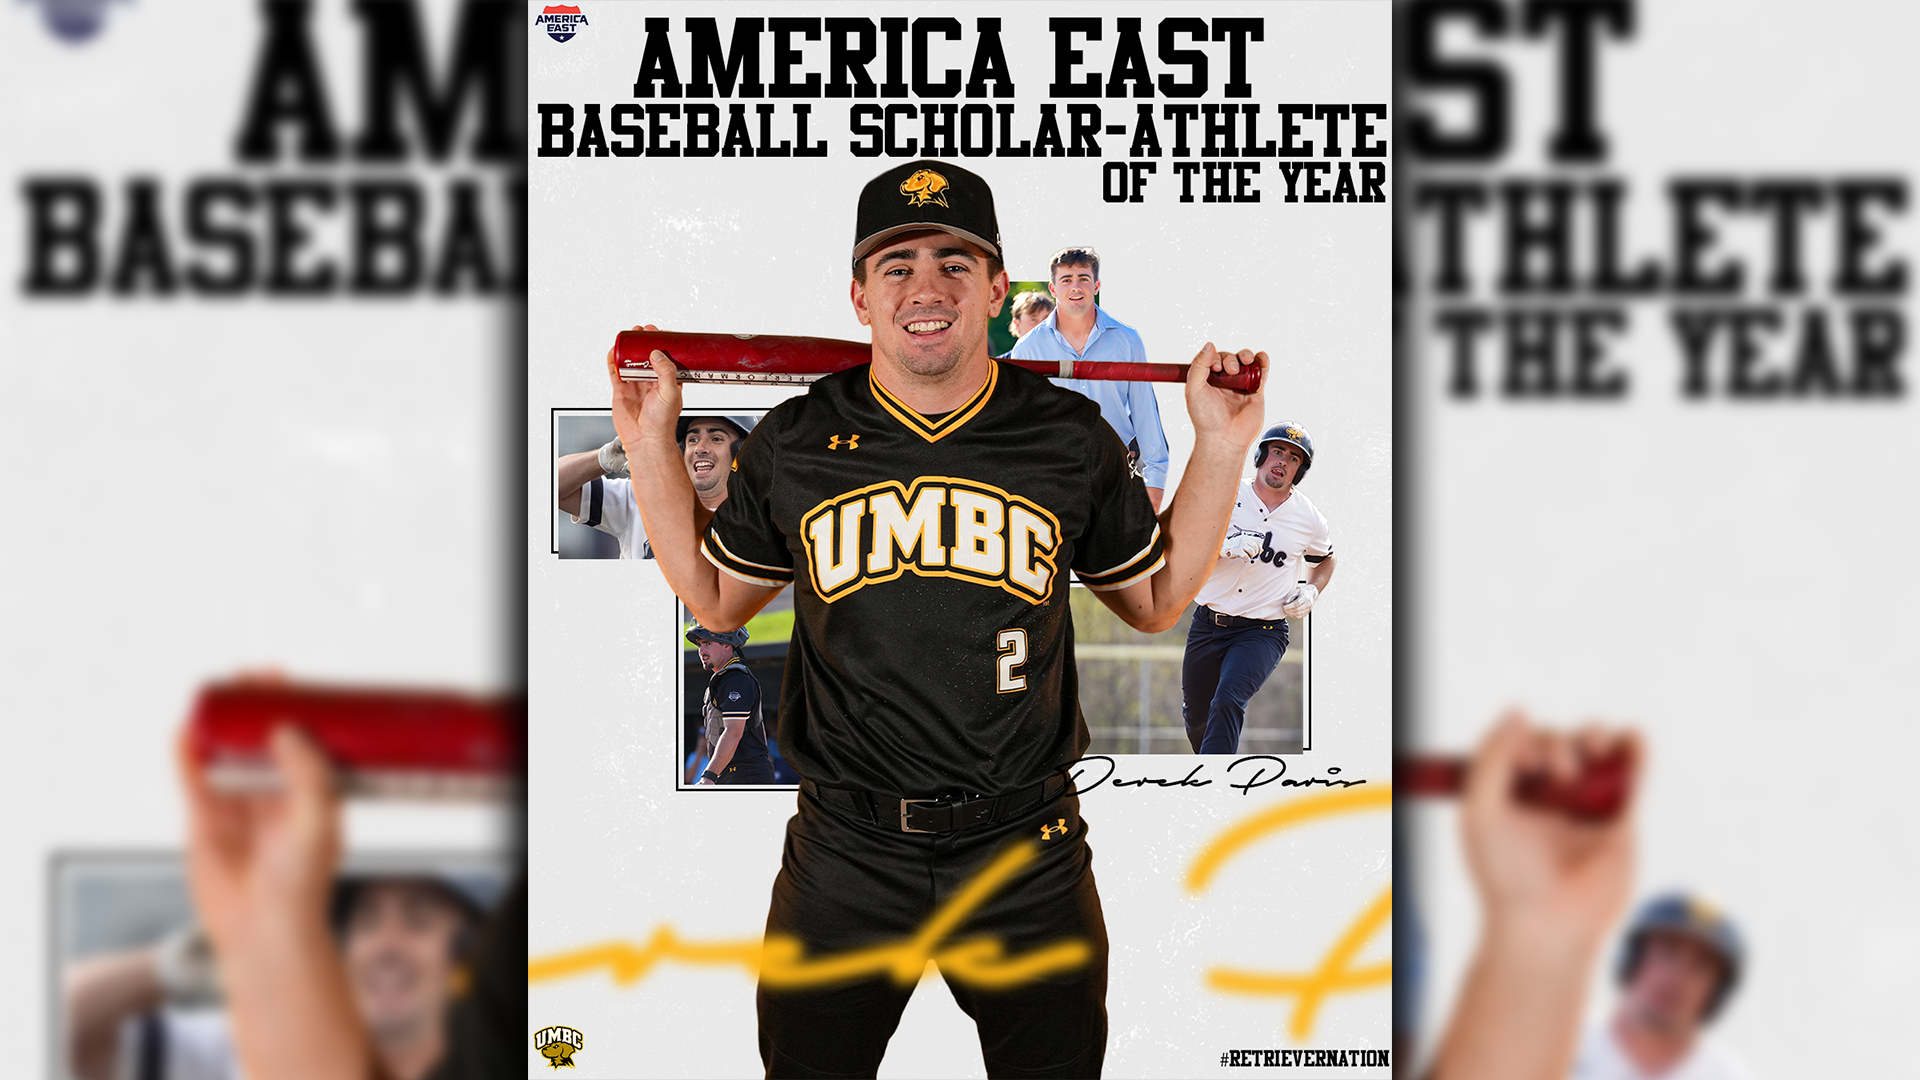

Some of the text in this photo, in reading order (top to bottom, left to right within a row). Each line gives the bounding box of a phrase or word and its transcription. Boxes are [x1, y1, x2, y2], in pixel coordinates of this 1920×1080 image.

[680, 371, 806, 383] PERFORMANC
[803, 479, 1060, 602] UMBC
[1258, 531, 1287, 568] bc
[997, 628, 1028, 694] 2
